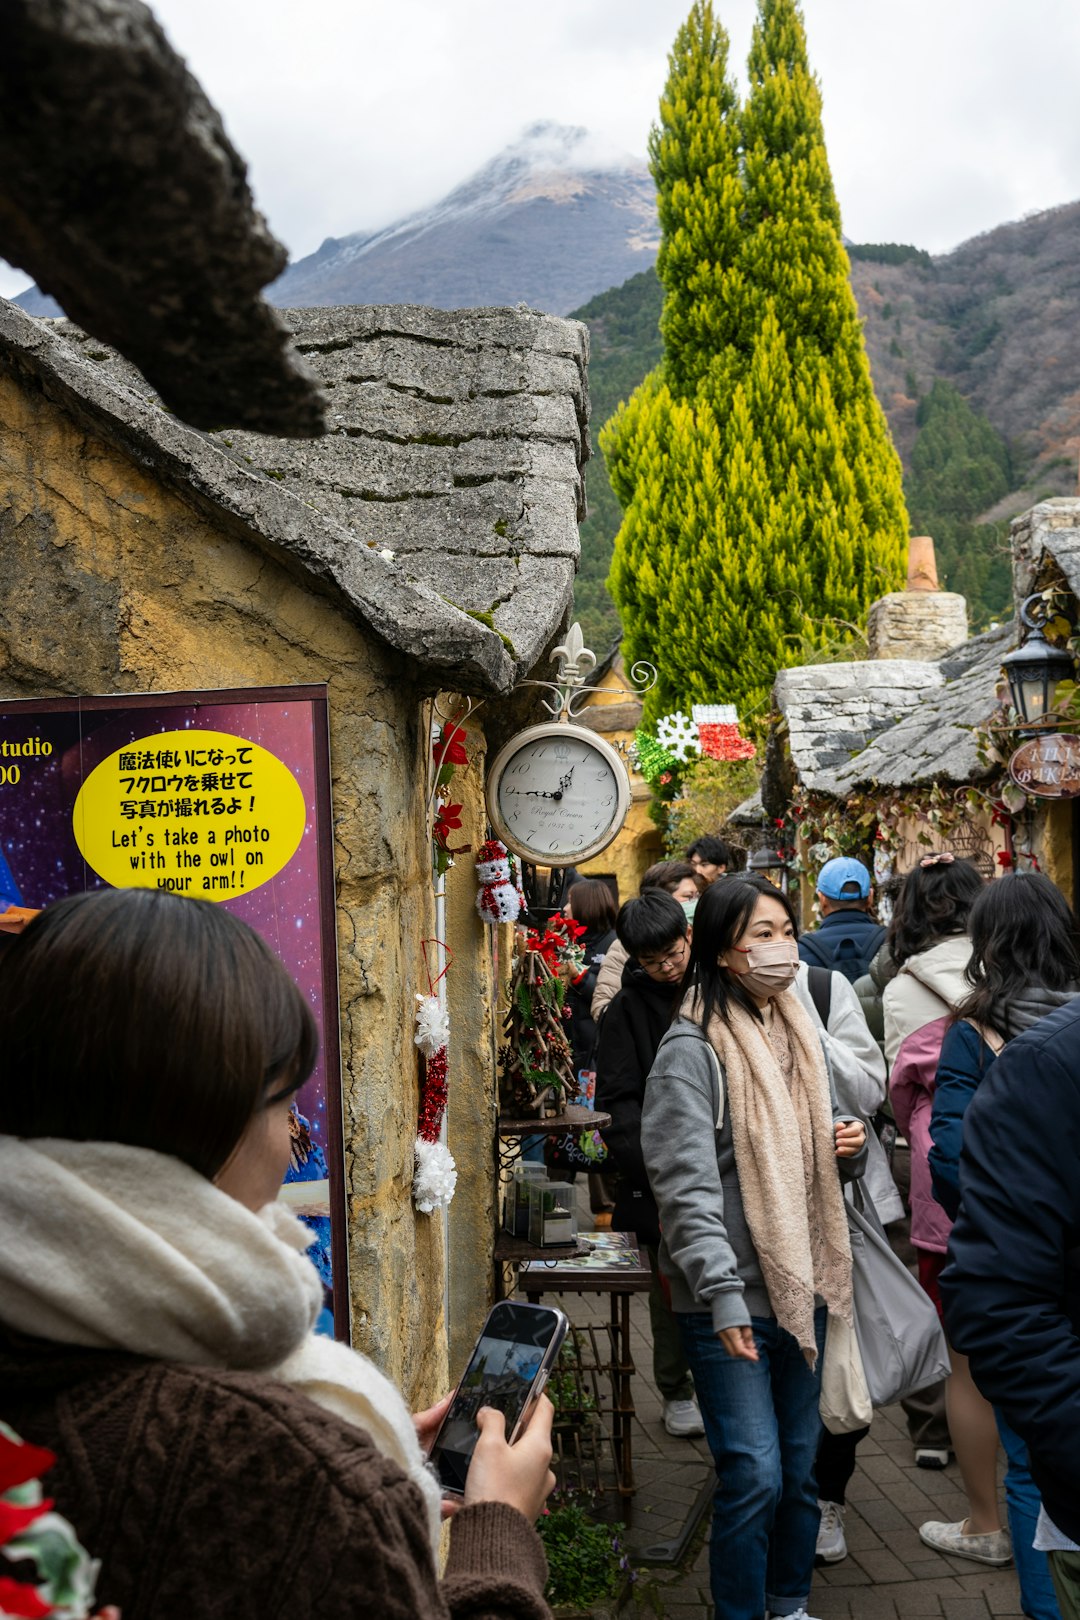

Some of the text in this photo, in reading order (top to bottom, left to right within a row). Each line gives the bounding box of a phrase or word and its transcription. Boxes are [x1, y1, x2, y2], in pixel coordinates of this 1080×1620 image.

[0, 737, 53, 757] tudio
[119, 747, 253, 771] 魔法使いになって
[512, 763, 531, 774] 10
[119, 772, 253, 794] フクロウを乗せて
[601, 794, 613, 807] 3
[508, 810, 522, 823] 8
[531, 806, 584, 819] Royal Crown
[112, 825, 270, 848] Let's take a photo
[526, 829, 538, 842] 7
[548, 838, 560, 851] 6
[130, 848, 263, 870] with the owl on
[157, 870, 245, 891] your arm!!
[557, 1133, 593, 1166] Japan
